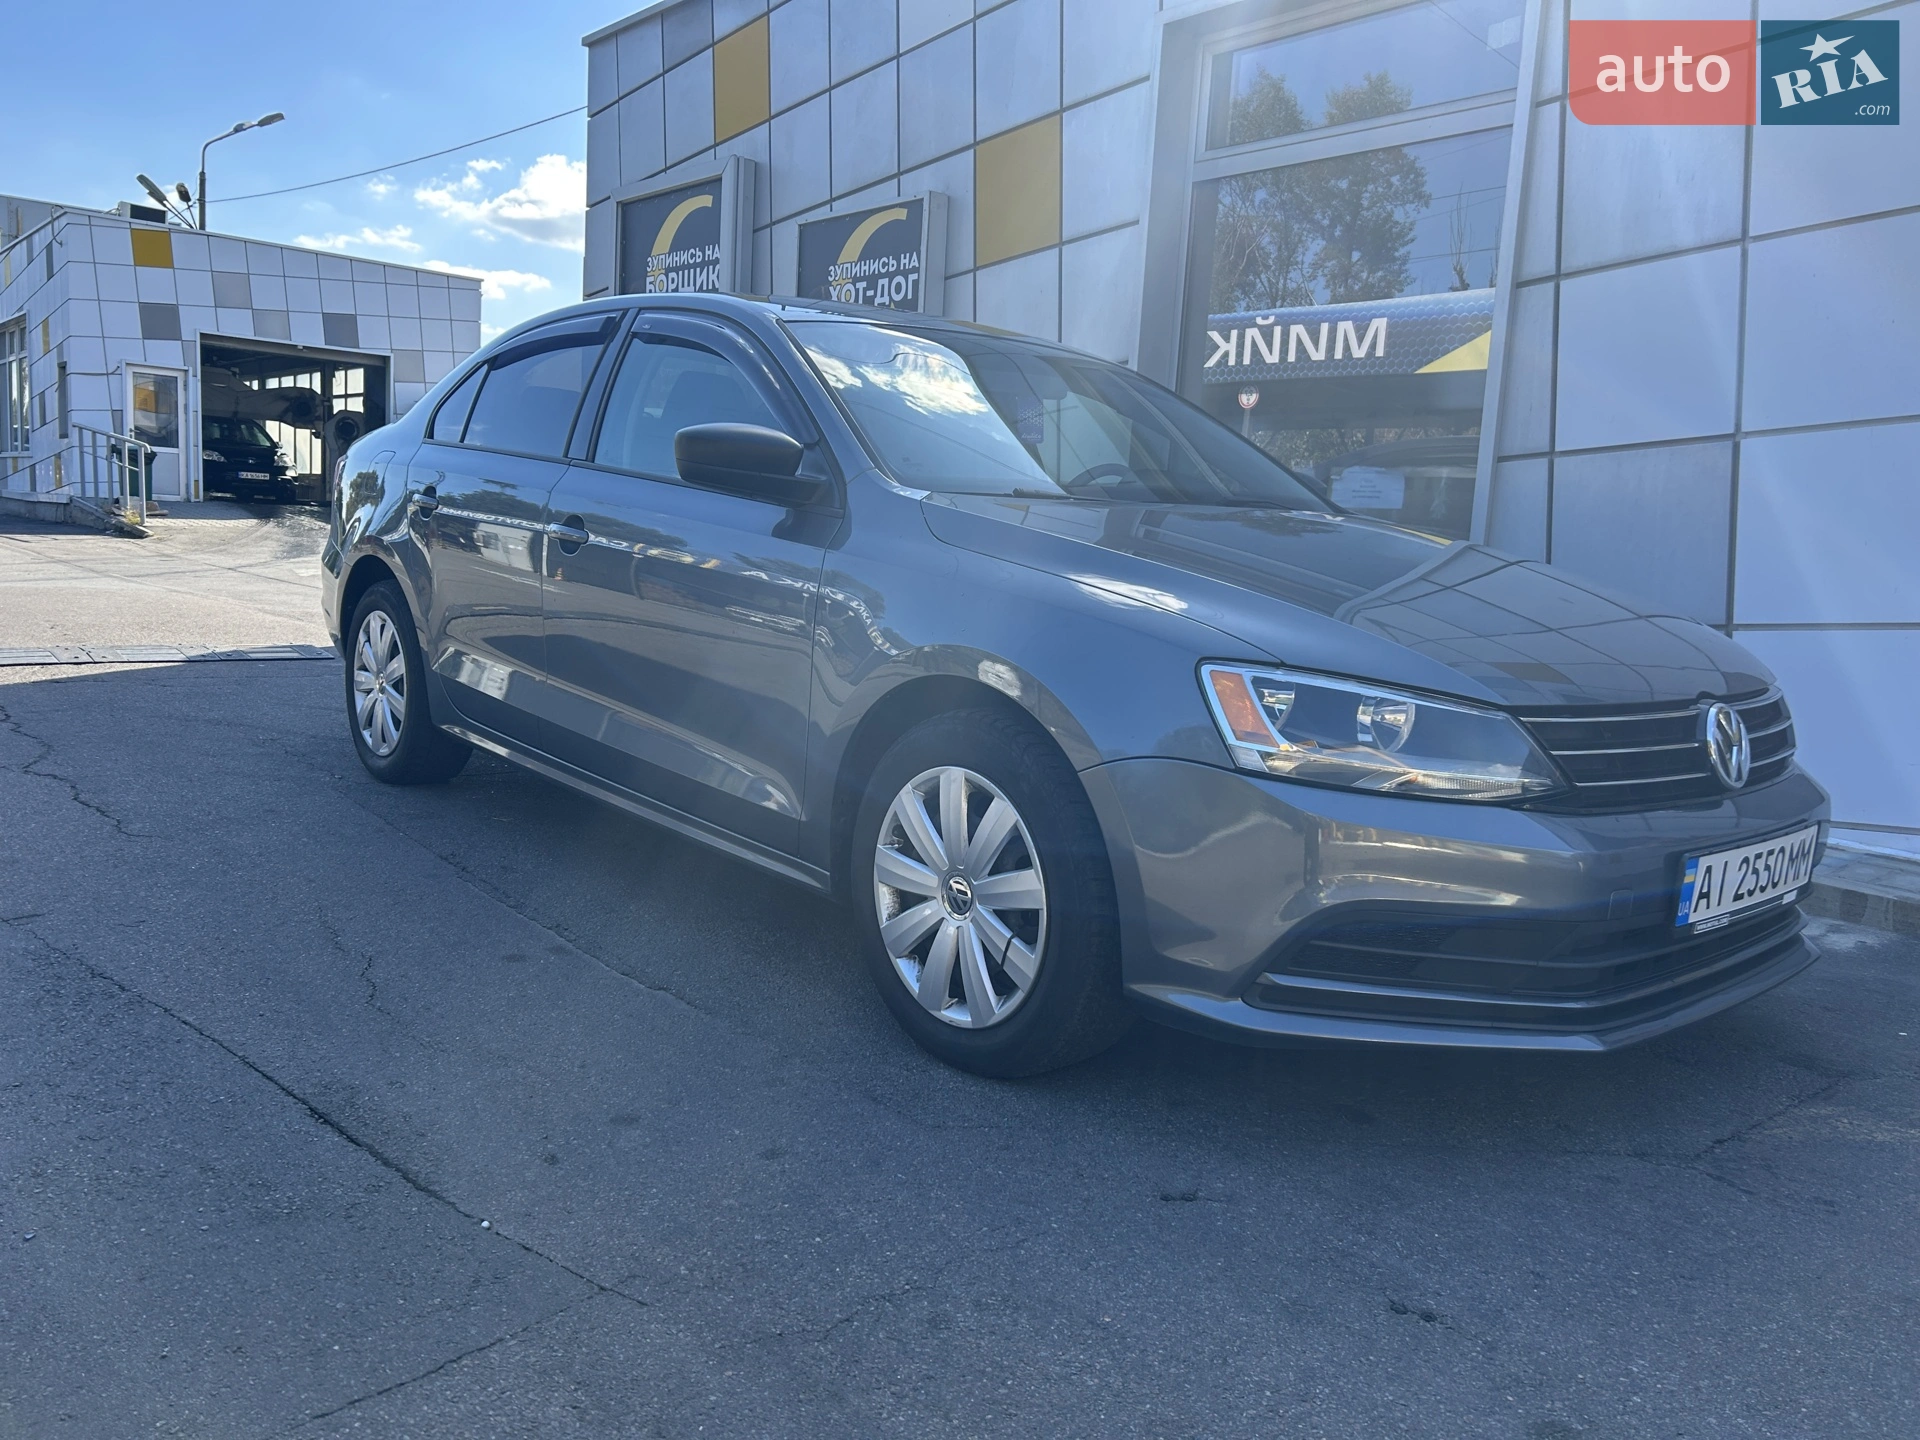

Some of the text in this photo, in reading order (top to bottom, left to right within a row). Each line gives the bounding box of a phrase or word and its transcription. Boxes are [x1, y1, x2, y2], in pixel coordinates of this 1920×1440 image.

[646, 243, 720, 272] ЗУПИНИСЬ НА
[828, 251, 919, 281] ЗУПИНИСЬ НА
[645, 264, 720, 293] БОРЩИК
[828, 272, 918, 306] ХОТ-ДОГ
[1692, 834, 1814, 913] AI 2550 MM
[1677, 901, 1690, 916] UA
